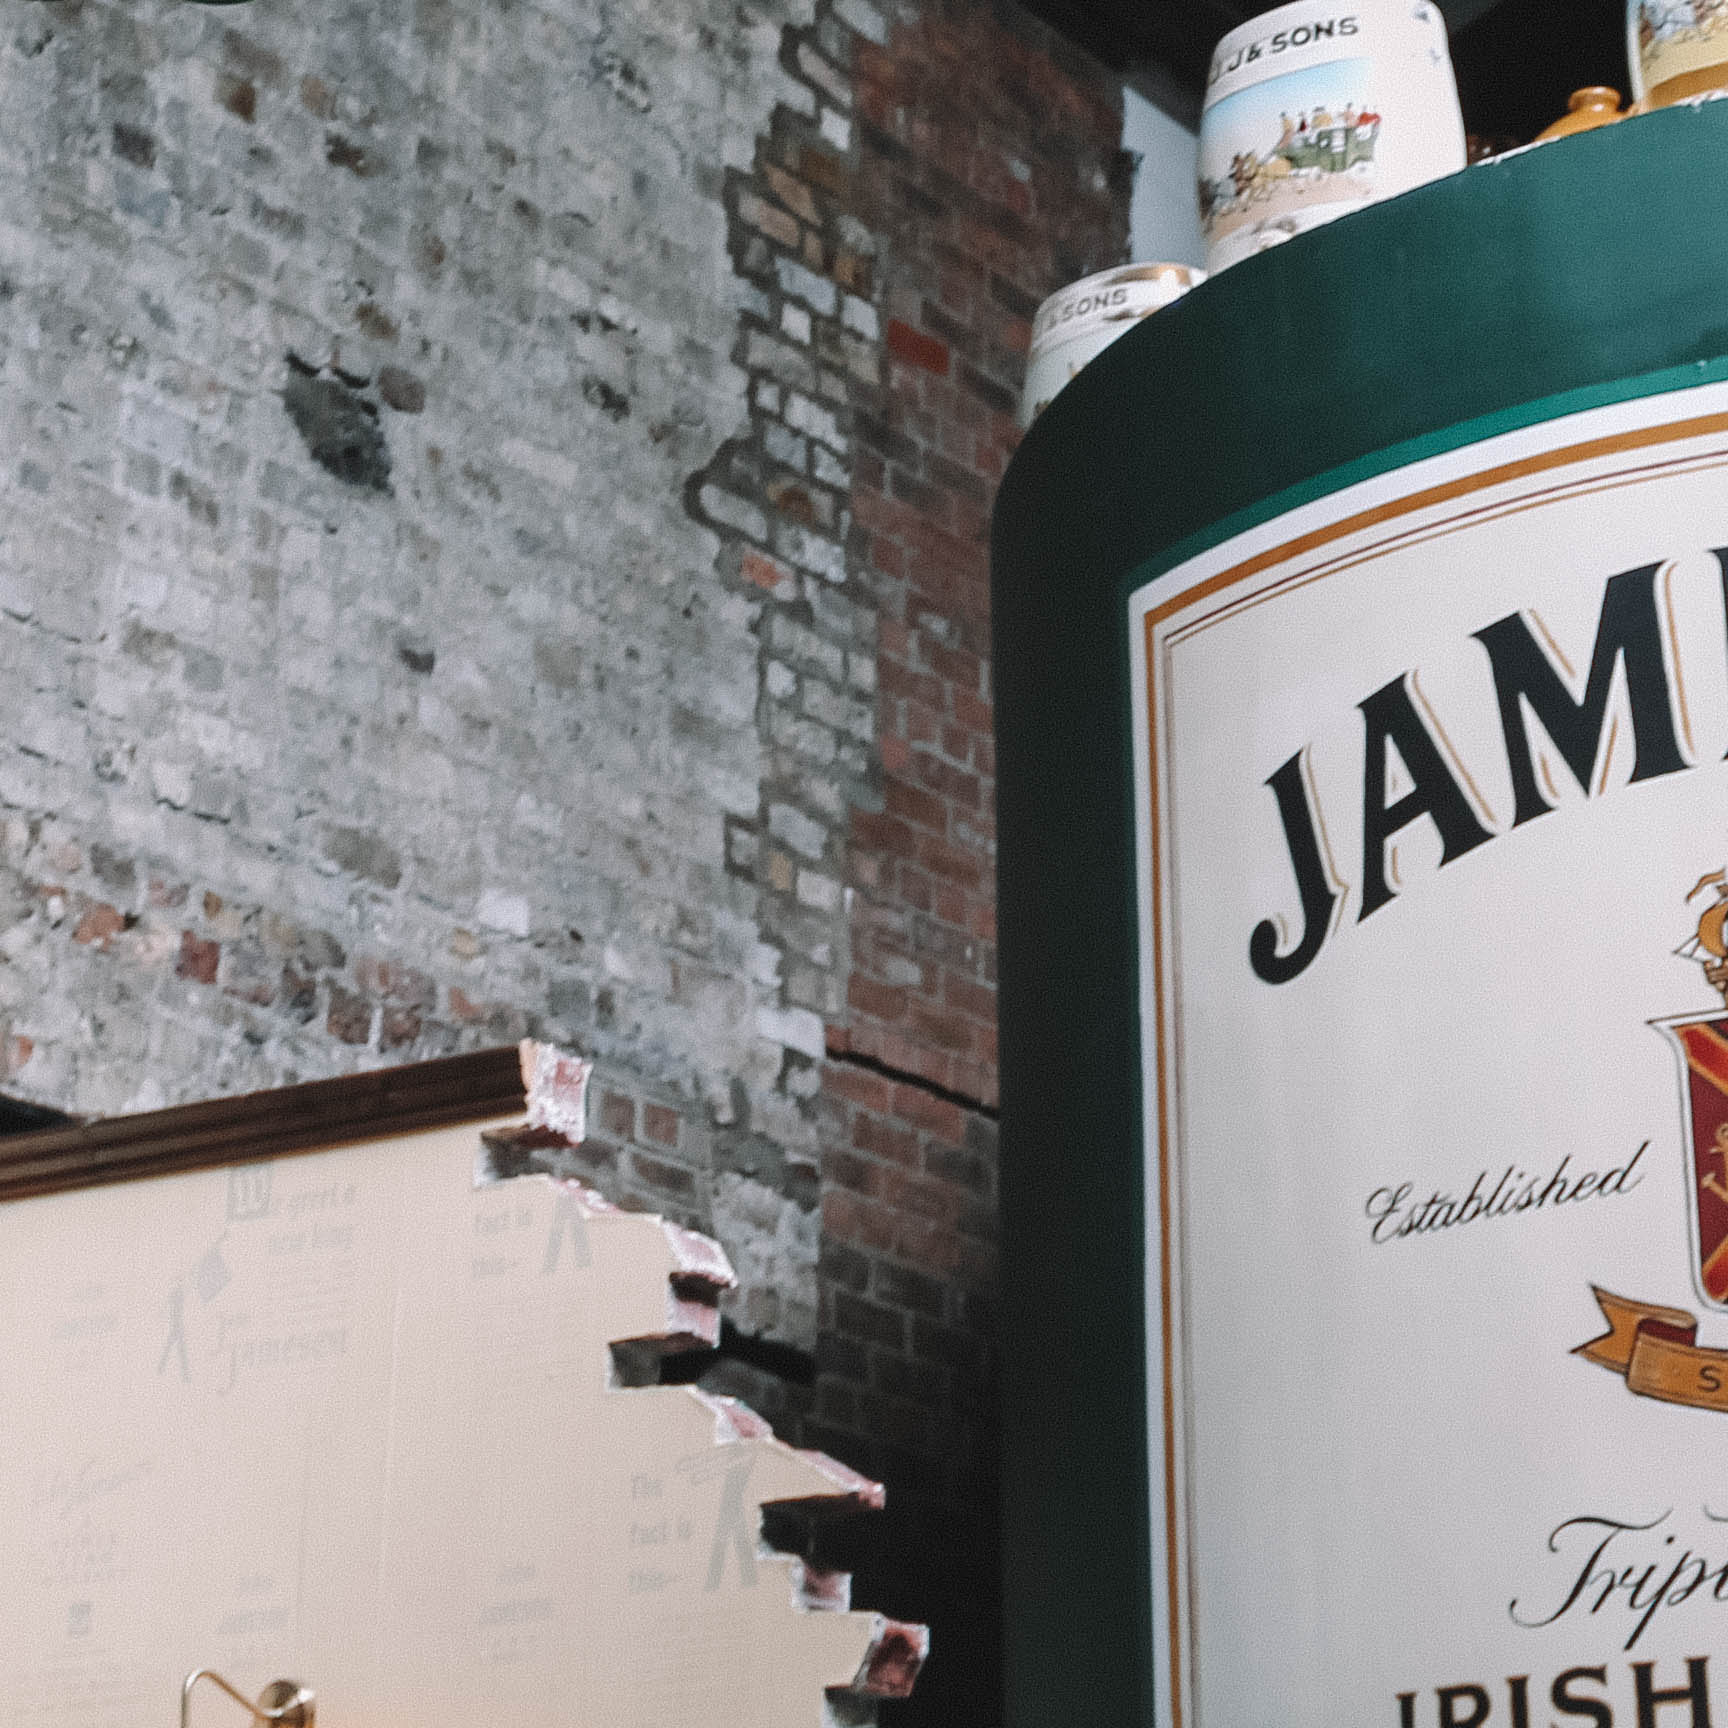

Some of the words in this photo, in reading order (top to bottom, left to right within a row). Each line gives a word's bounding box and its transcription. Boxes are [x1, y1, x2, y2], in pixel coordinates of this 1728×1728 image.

[1271, 16, 1359, 55] SONS
[1062, 287, 1129, 324] SONS
[1364, 1140, 1651, 1245] Established
